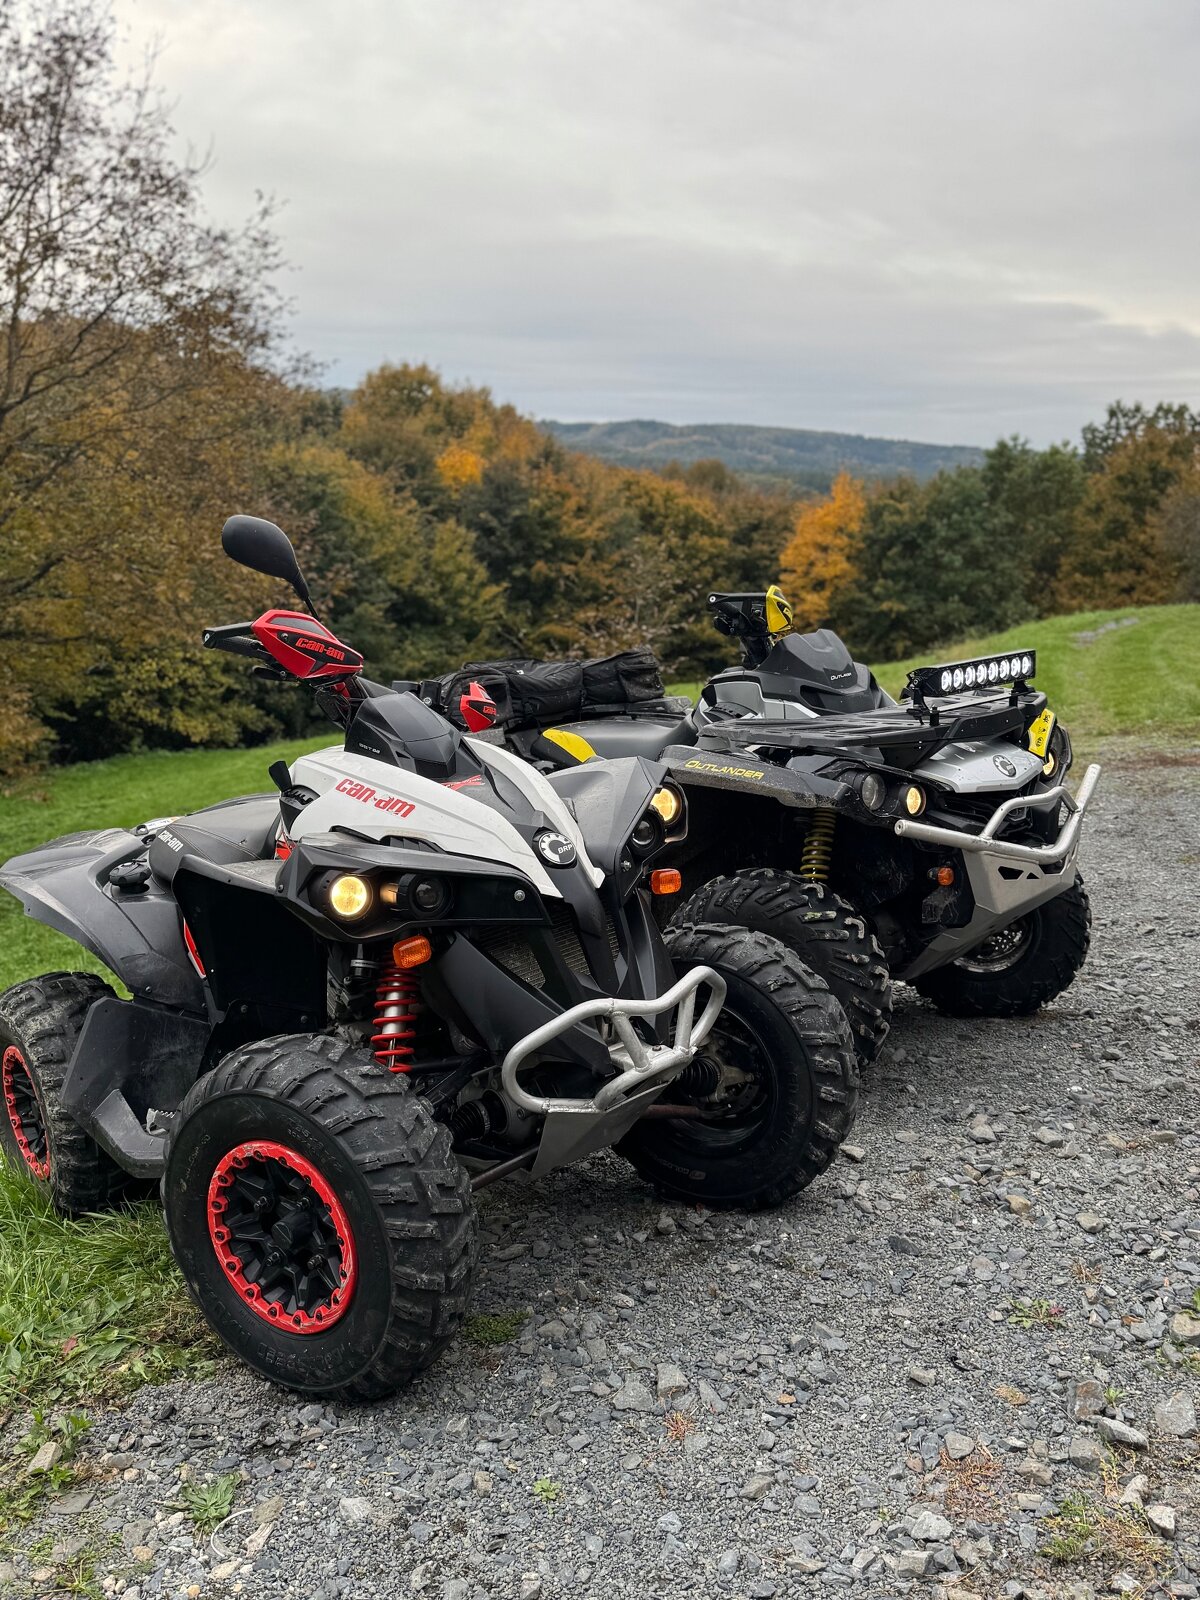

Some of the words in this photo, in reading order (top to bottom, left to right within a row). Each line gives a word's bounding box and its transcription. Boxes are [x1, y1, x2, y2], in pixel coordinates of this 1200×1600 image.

[295, 637, 345, 661] can-am
[684, 760, 765, 780] OUTLANDER
[335, 778, 416, 818] can-am
[157, 830, 184, 852] can-am
[557, 843, 573, 855] BRP
